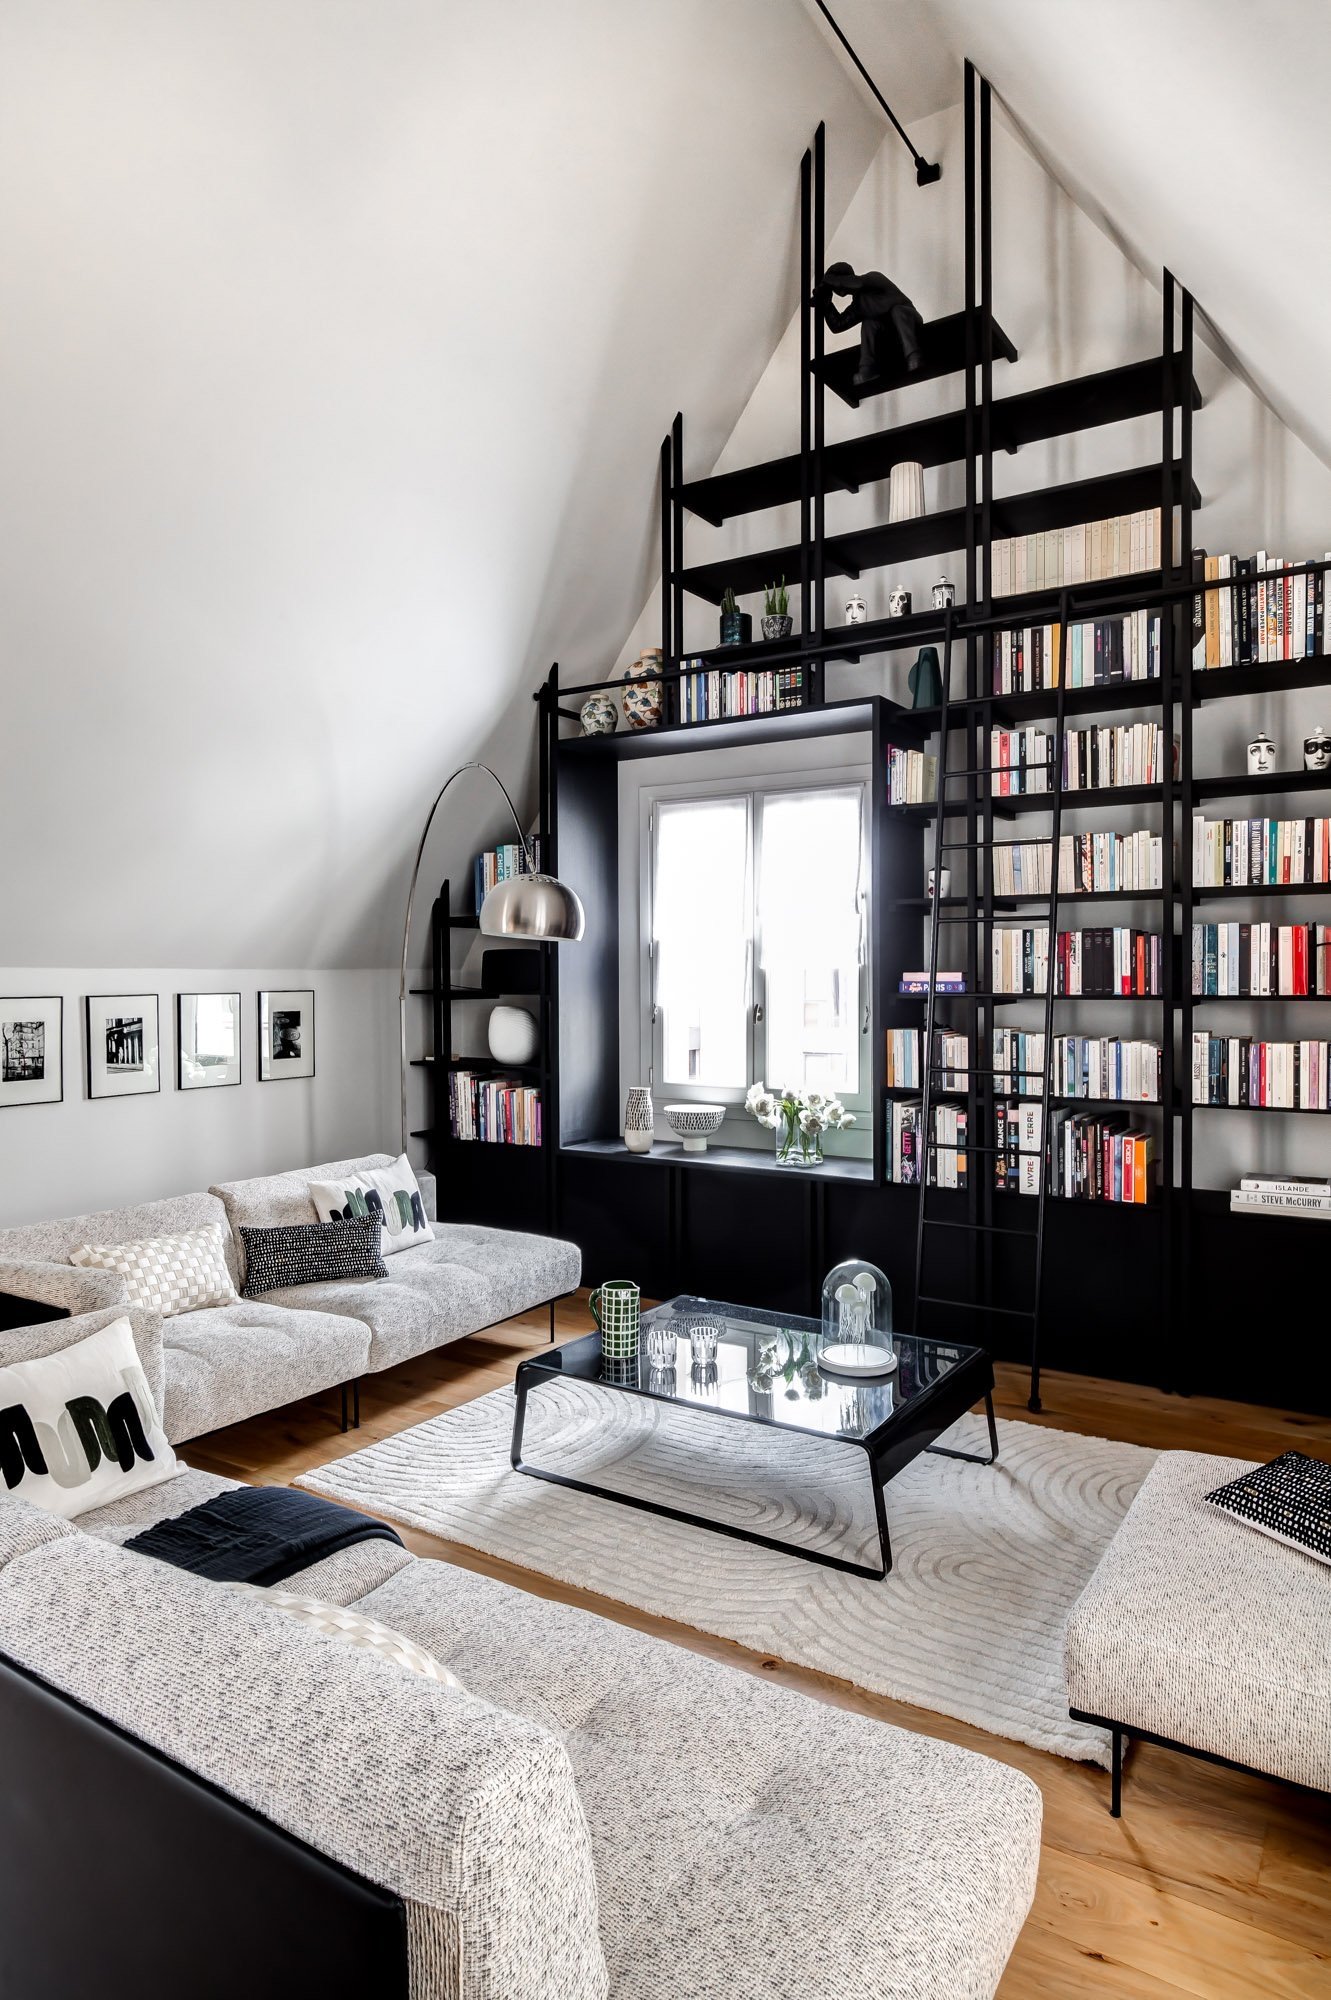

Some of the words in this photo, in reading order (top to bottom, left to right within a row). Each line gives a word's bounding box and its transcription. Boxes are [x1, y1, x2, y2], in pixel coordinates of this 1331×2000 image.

[1192, 594, 1202, 627] aravage
[923, 983, 945, 991] PRIS
[903, 1132, 911, 1154] GETTY
[1275, 1184, 1310, 1193] ISLANDE
[1261, 1194, 1284, 1205] STEVE
[1285, 1196, 1322, 1208] McCURRY
